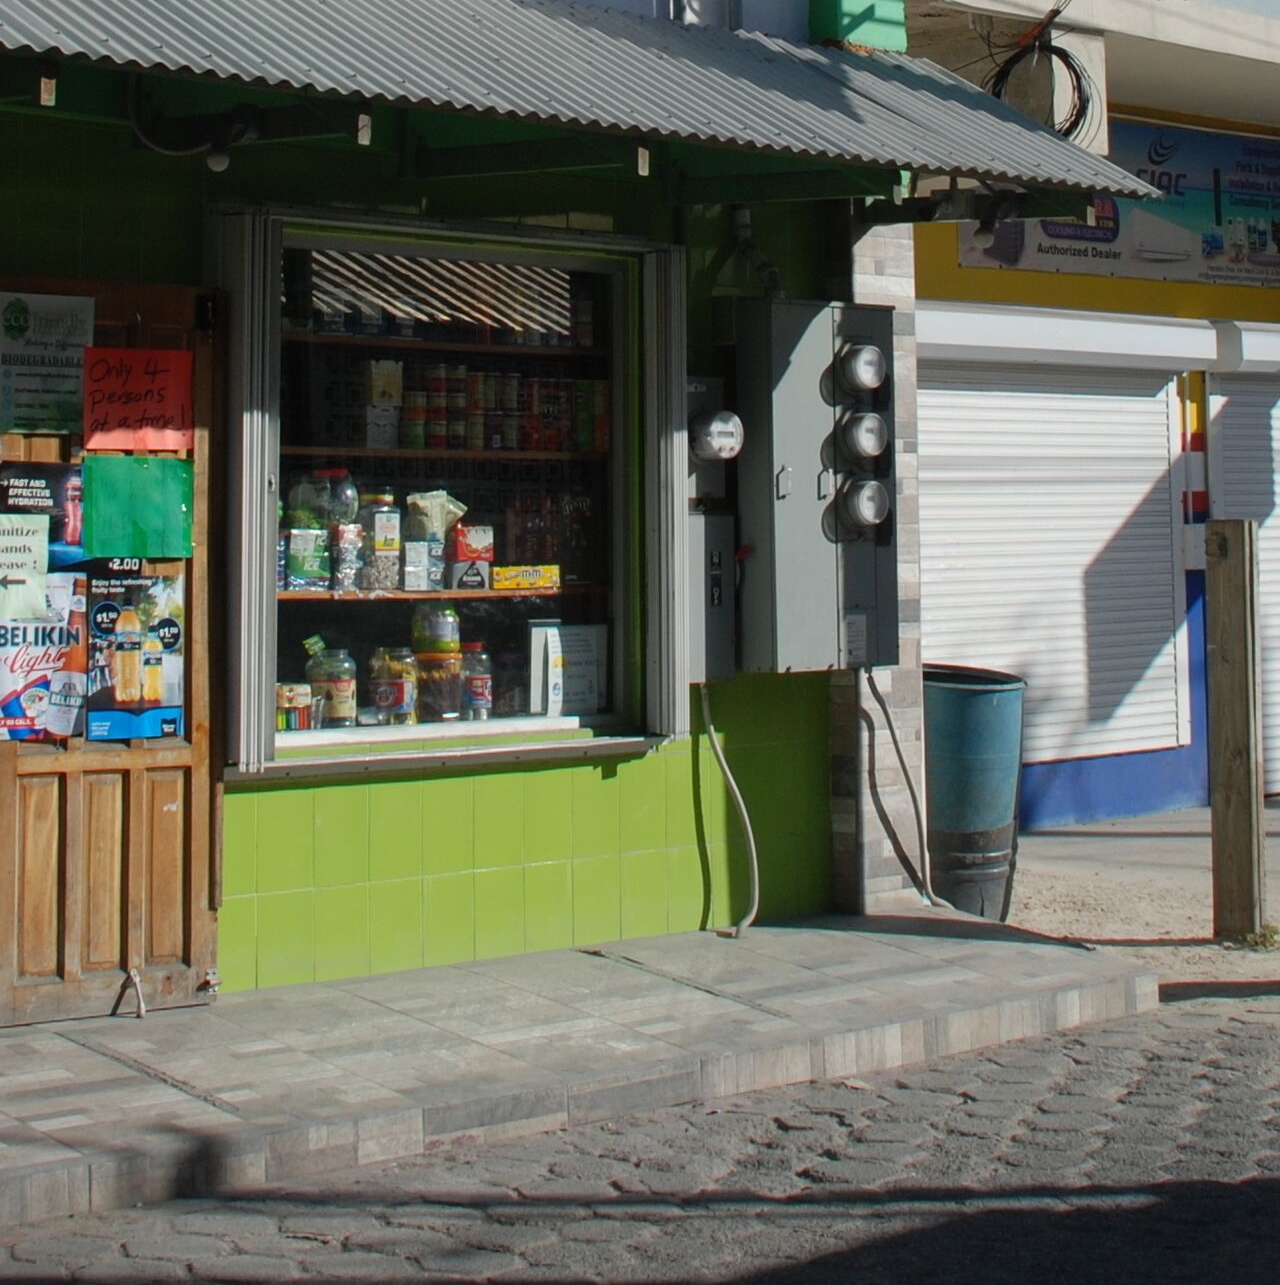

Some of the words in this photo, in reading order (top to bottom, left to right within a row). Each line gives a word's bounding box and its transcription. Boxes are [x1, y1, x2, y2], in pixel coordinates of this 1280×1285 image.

[1036, 243, 1089, 258] Authorized
[1091, 246, 1122, 260] Dealer
[89, 358, 133, 387] Only
[143, 359, 170, 385] 4
[89, 387, 167, 415] persons
[90, 412, 108, 434] at
[117, 417, 131, 429] a
[9, 478, 28, 487] FAST
[29, 479, 46, 487] AND
[8, 488, 51, 497] EFFECTIVE
[8, 497, 54, 507] HYDRATION
[108, 558, 140, 571] $2.00
[122, 579, 153, 587] refreshing
[4, 644, 68, 675] light
